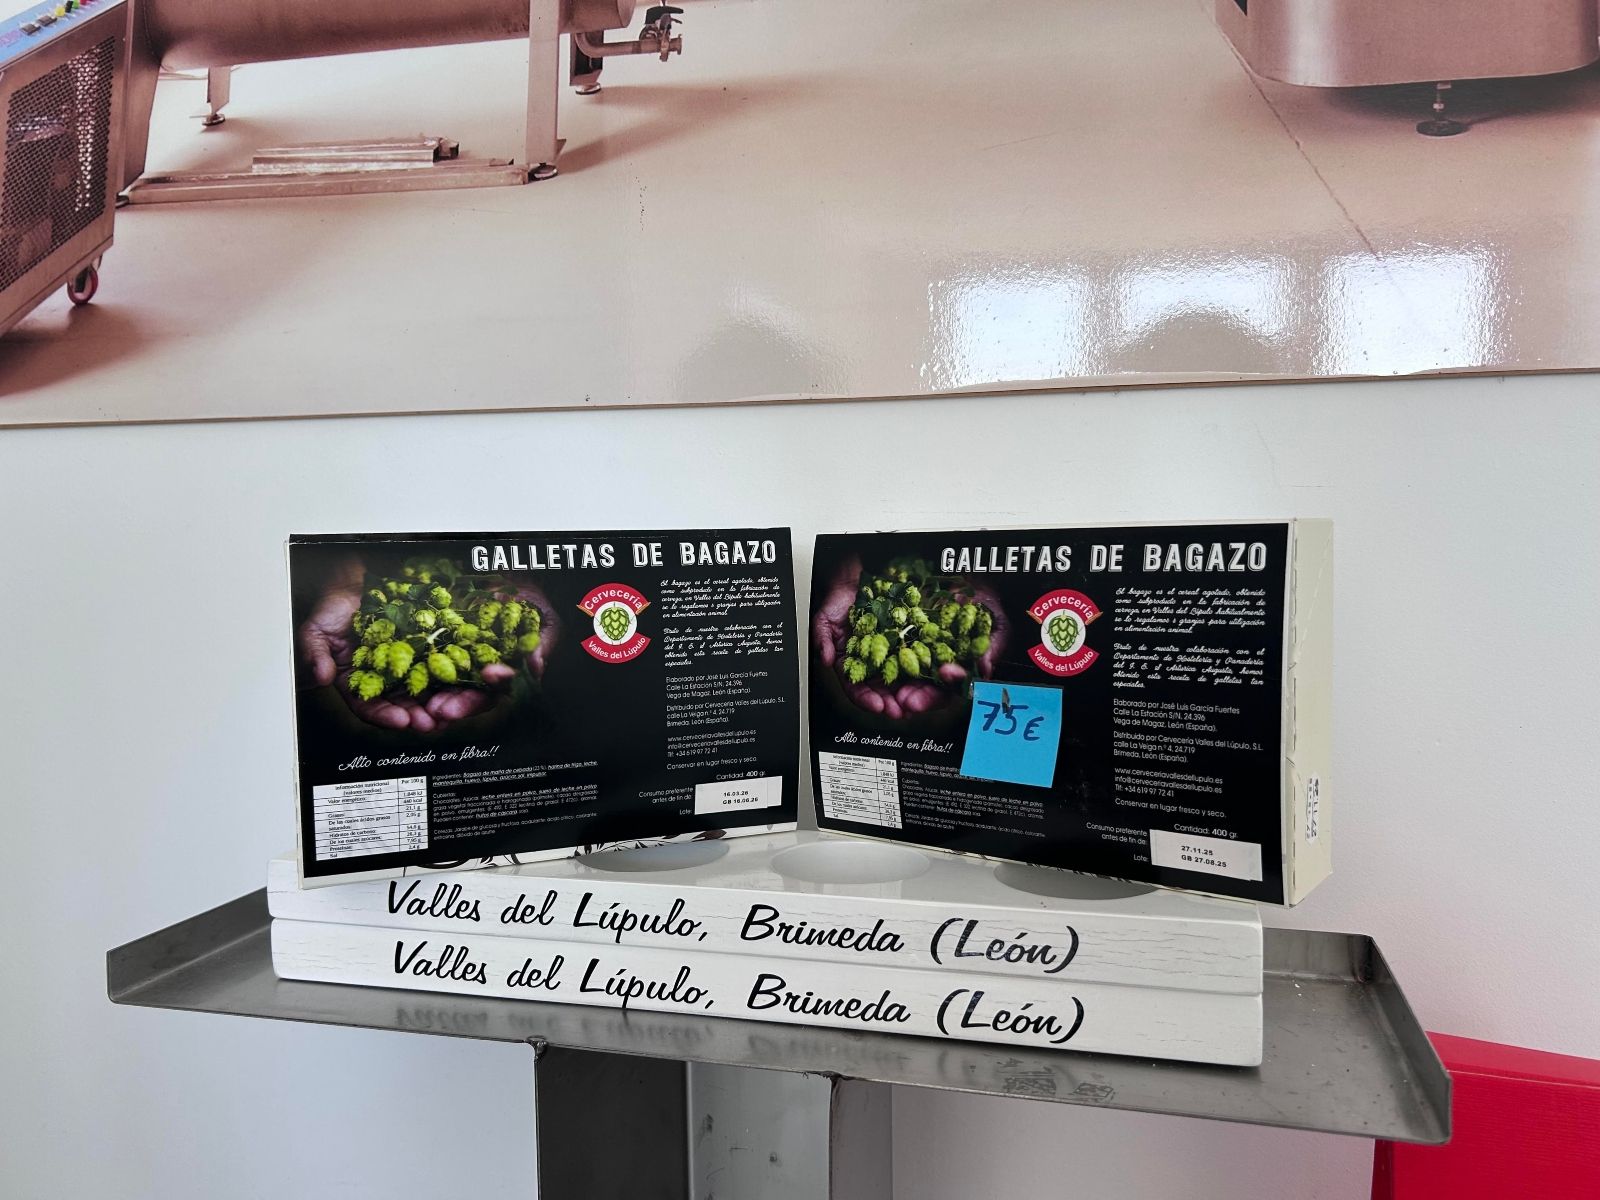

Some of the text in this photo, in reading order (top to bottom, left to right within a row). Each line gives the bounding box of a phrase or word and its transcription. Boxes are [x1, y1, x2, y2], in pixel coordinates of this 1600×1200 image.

[472, 540, 776, 571] GALLETAS DE BAGAZO
[940, 542, 1267, 573] GALLETAS DE BAGAZO
[584, 589, 642, 610] Cervecería
[1128, 588, 1152, 597] bagazo
[1033, 595, 1094, 621] Cervecería
[1137, 597, 1176, 606] subproducto
[1212, 598, 1250, 606] fabricación
[1189, 607, 1213, 616] Lúpulo
[1179, 618, 1205, 626] granjas
[1229, 618, 1265, 628] utilización
[588, 637, 646, 659] Valles del Lúpulo
[1186, 646, 1229, 654] colaboración
[1034, 649, 1094, 672] Valles del Lúpulo
[1114, 652, 1159, 661] Departamento
[1176, 655, 1212, 663] Hostelería
[1216, 658, 1220, 666] y
[1225, 657, 1263, 665] Panadería
[1239, 667, 1263, 675] hemos
[1214, 676, 1242, 685] galletas
[1114, 699, 1146, 708] Elaborado
[1148, 701, 1159, 709] por
[1177, 703, 1189, 711] Luis
[1190, 704, 1213, 713] García
[1215, 705, 1240, 714] Fuertes
[1141, 710, 1167, 718] Estación
[1184, 713, 1205, 721] 24.396
[1114, 717, 1130, 726] Vega
[1168, 721, 1184, 729] León
[835, 732, 857, 742] Alto
[861, 735, 903, 748] contenido
[920, 739, 953, 753] fibra!!
[1114, 731, 1144, 740] Distribuido
[1146, 735, 1157, 743] por
[1158, 734, 1193, 744] Cervecería
[1195, 738, 1214, 746] Valles
[338, 746, 499, 771] Alto contenido en fibra!!
[1142, 752, 1157, 760] León
[1115, 798, 1148, 808] Conservar
[1150, 802, 1158, 810] en
[1160, 803, 1177, 813] lugar
[1179, 805, 1200, 814] fresco
[1207, 810, 1226, 818] seco.
[1086, 822, 1147, 837] Consumo preferente
[1174, 824, 1210, 834] Cantidad:
[1212, 829, 1227, 837] 400
[1102, 833, 1118, 841] antes
[1181, 846, 1213, 856] 27.11.25
[1194, 857, 1227, 868] 27.08.25
[388, 879, 1079, 974] Valles del Lúpulo, Brimeda (León)
[394, 940, 1085, 1044] Valles del Lúpulo, Brimeda (León)
